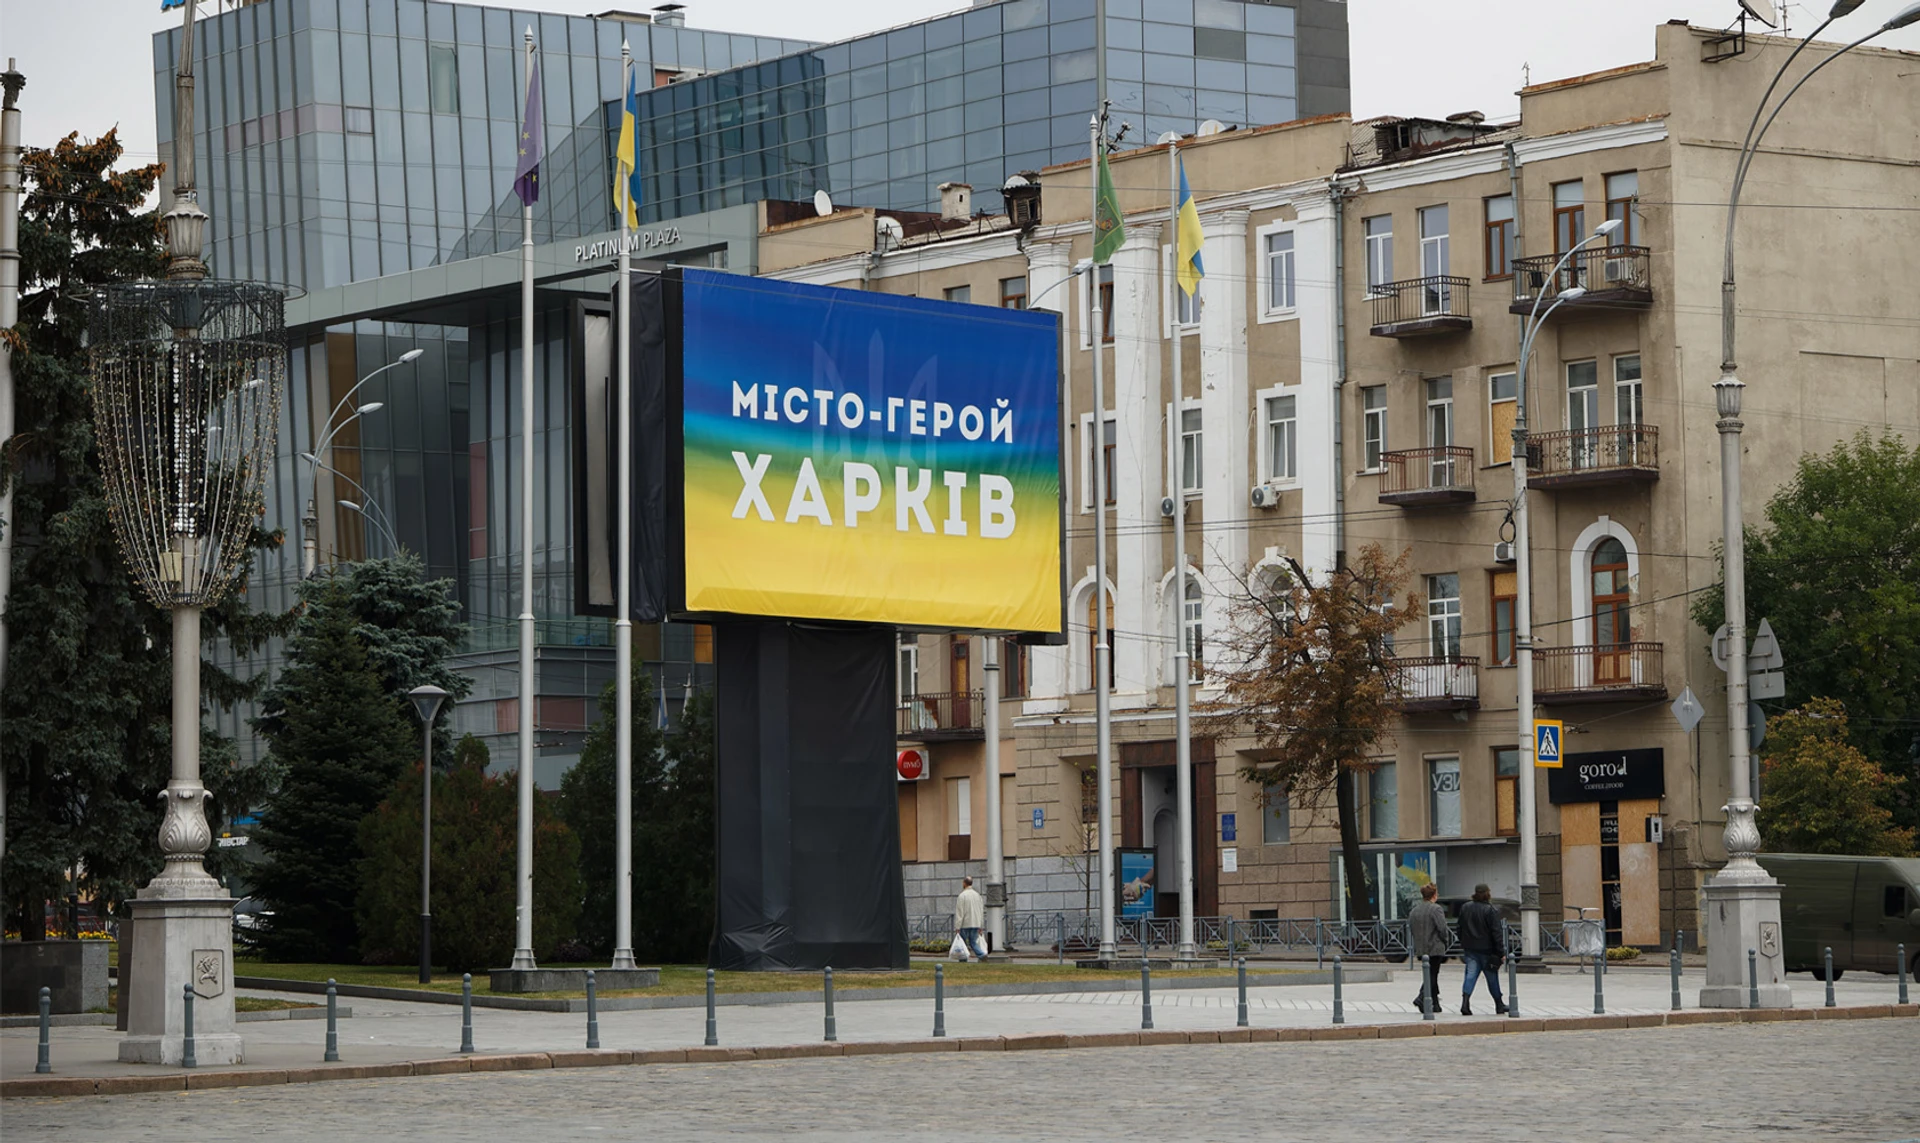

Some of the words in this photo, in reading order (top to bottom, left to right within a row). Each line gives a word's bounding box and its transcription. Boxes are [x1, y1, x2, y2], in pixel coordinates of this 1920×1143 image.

[643, 226, 681, 249] PLAZA
[732, 380, 1013, 443] МІСТО-ГЕРОЙ
[731, 451, 1016, 539] ХАРКІВ
[1580, 756, 1627, 783] gorod
